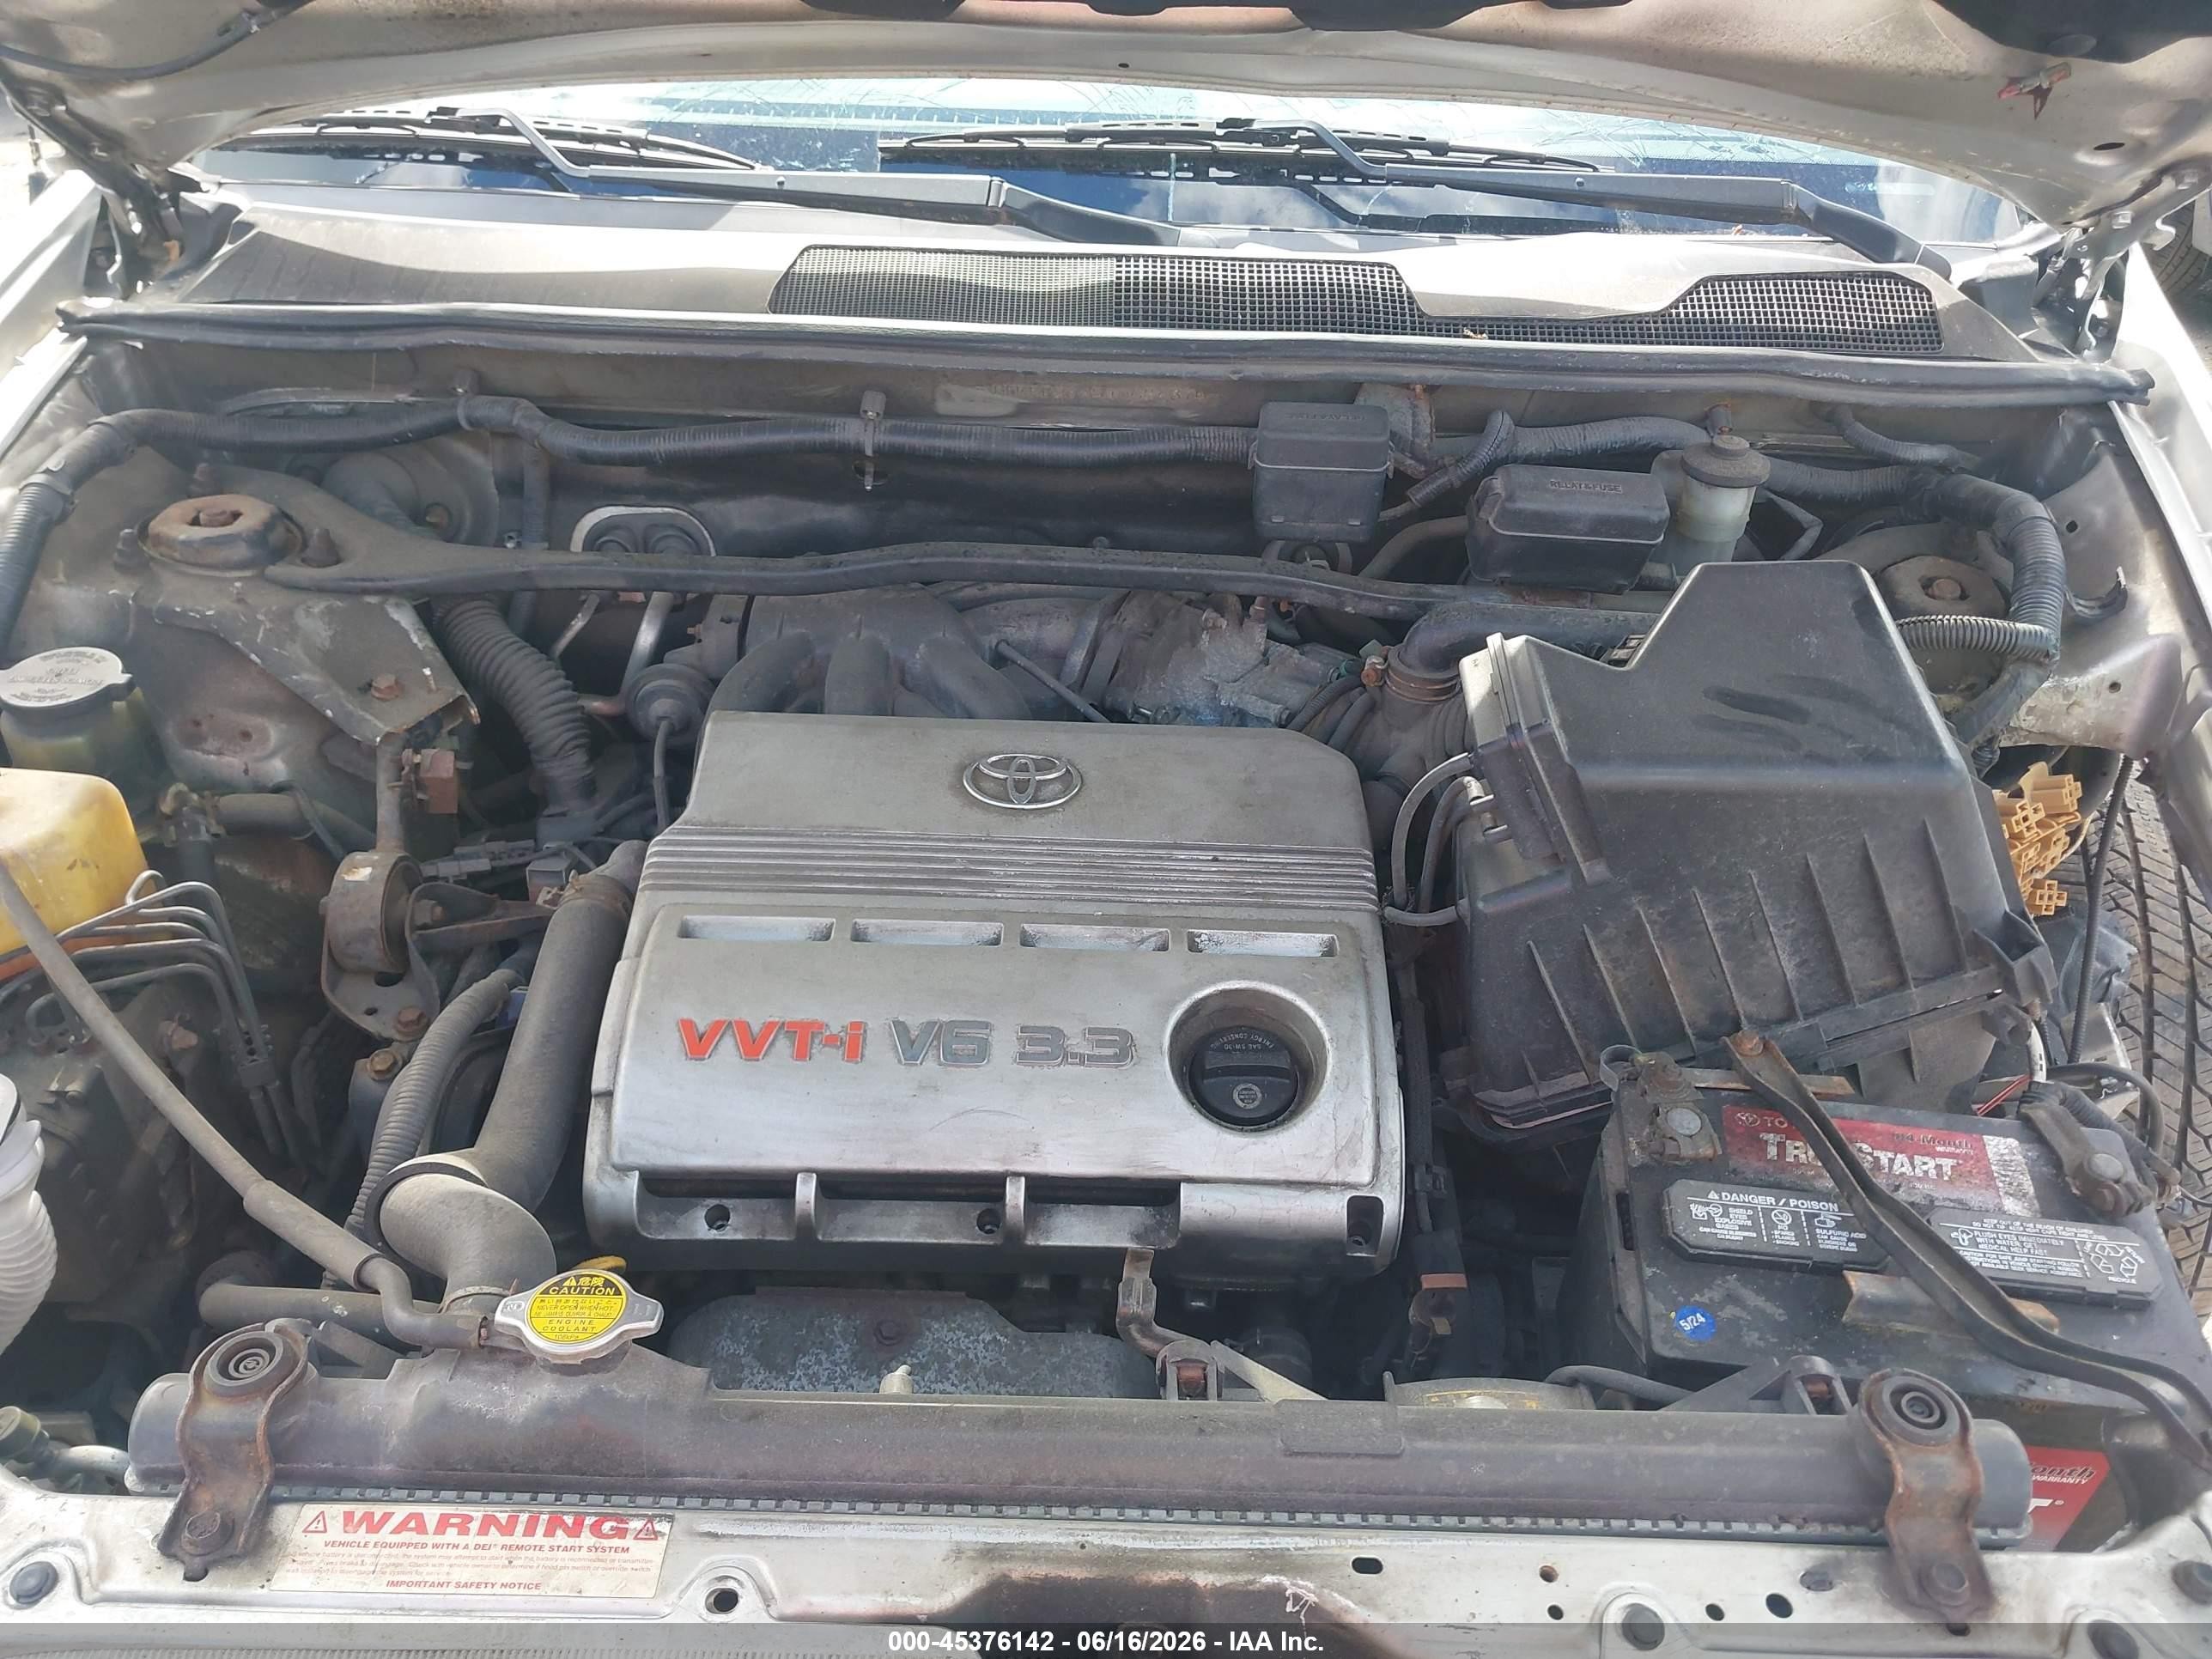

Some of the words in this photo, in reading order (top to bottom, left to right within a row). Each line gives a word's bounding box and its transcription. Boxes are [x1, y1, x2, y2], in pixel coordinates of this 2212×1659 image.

[1550, 479, 1622, 493] RELAY&FUSE
[678, 1019, 867, 1063] VVT-i
[890, 1019, 994, 1067] V6
[1016, 1024, 1138, 1068] 3.3
[1722, 1192, 1776, 1206] DANGER
[1790, 1199, 1839, 1212] POISON
[1715, 1217, 1752, 1226] EXPLOSIVE
[1815, 1229, 1849, 1237] SULFURIC
[2018, 1235, 2064, 1246] IMMEDIATELY
[1978, 1243, 2009, 1252] MEDICAL
[2124, 1246, 2145, 1263] RETURN
[2108, 1276, 2137, 1285] RECYCLE
[1680, 1312, 1706, 1331] 5/24
[2030, 1463, 2096, 1480] onth
[2032, 1474, 2088, 1484] WARRANTY
[343, 1510, 629, 1540] WARNING
[324, 1540, 370, 1549] VEHICLE
[373, 1540, 428, 1550] EQUIPPED
[431, 1541, 459, 1550] WITH
[501, 1543, 545, 1553] REMOTE
[548, 1544, 583, 1553] START
[586, 1545, 630, 1553] SYSTEM
[386, 1579, 452, 1589] IMPORTANT
[454, 1580, 497, 1589] SAFETY
[500, 1582, 542, 1590] NOTICE
